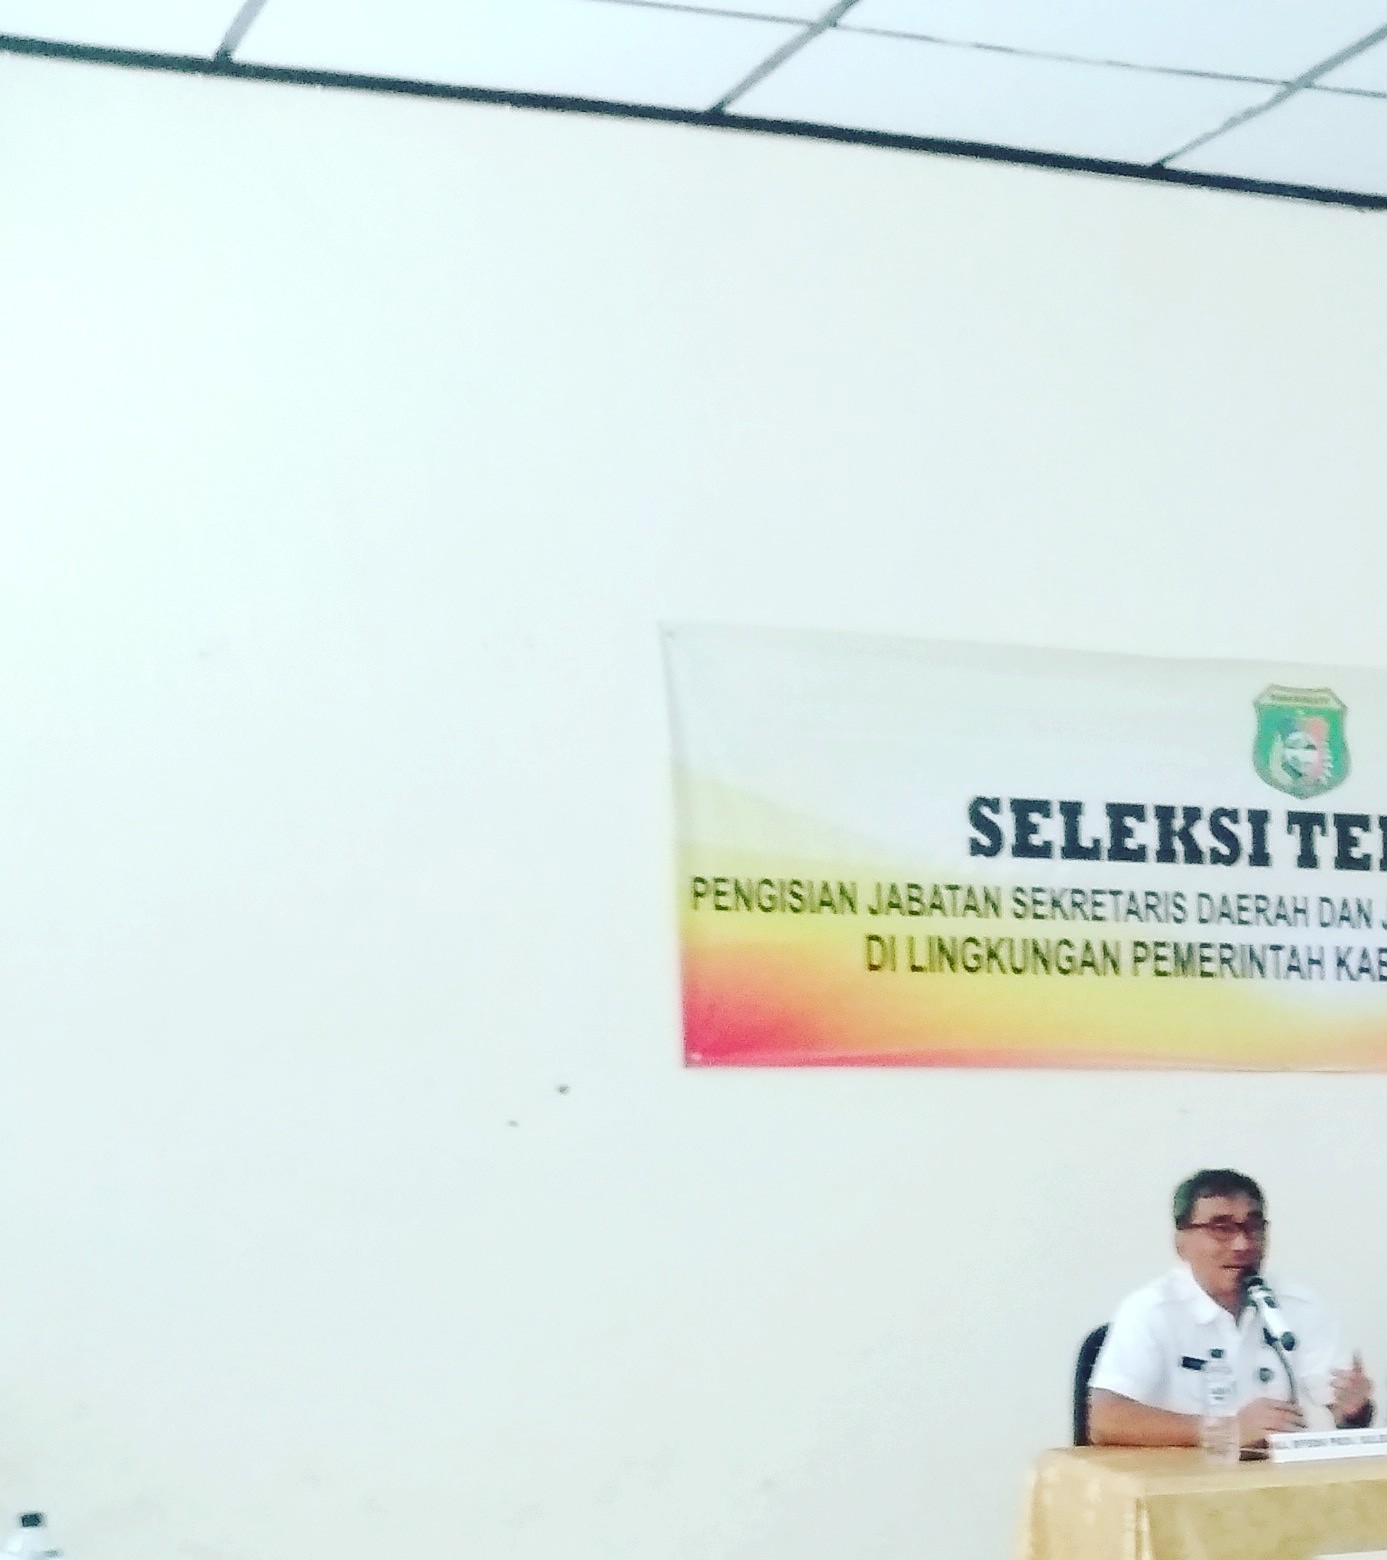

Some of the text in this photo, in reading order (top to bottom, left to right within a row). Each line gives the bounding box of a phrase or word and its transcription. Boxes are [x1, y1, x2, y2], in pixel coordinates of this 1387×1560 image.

[967, 796, 1272, 868] SELEKSI
[692, 876, 858, 915] PENGISIAN
[867, 881, 1001, 918] JABATAN
[1012, 886, 1187, 924] SEKRETARIS
[1198, 892, 1309, 928] DAERAH
[1318, 896, 1373, 930] DAN
[865, 934, 897, 972] DI
[908, 935, 1121, 977] LINGKUNGAN
[1132, 940, 1326, 980] PEMERINTAH
